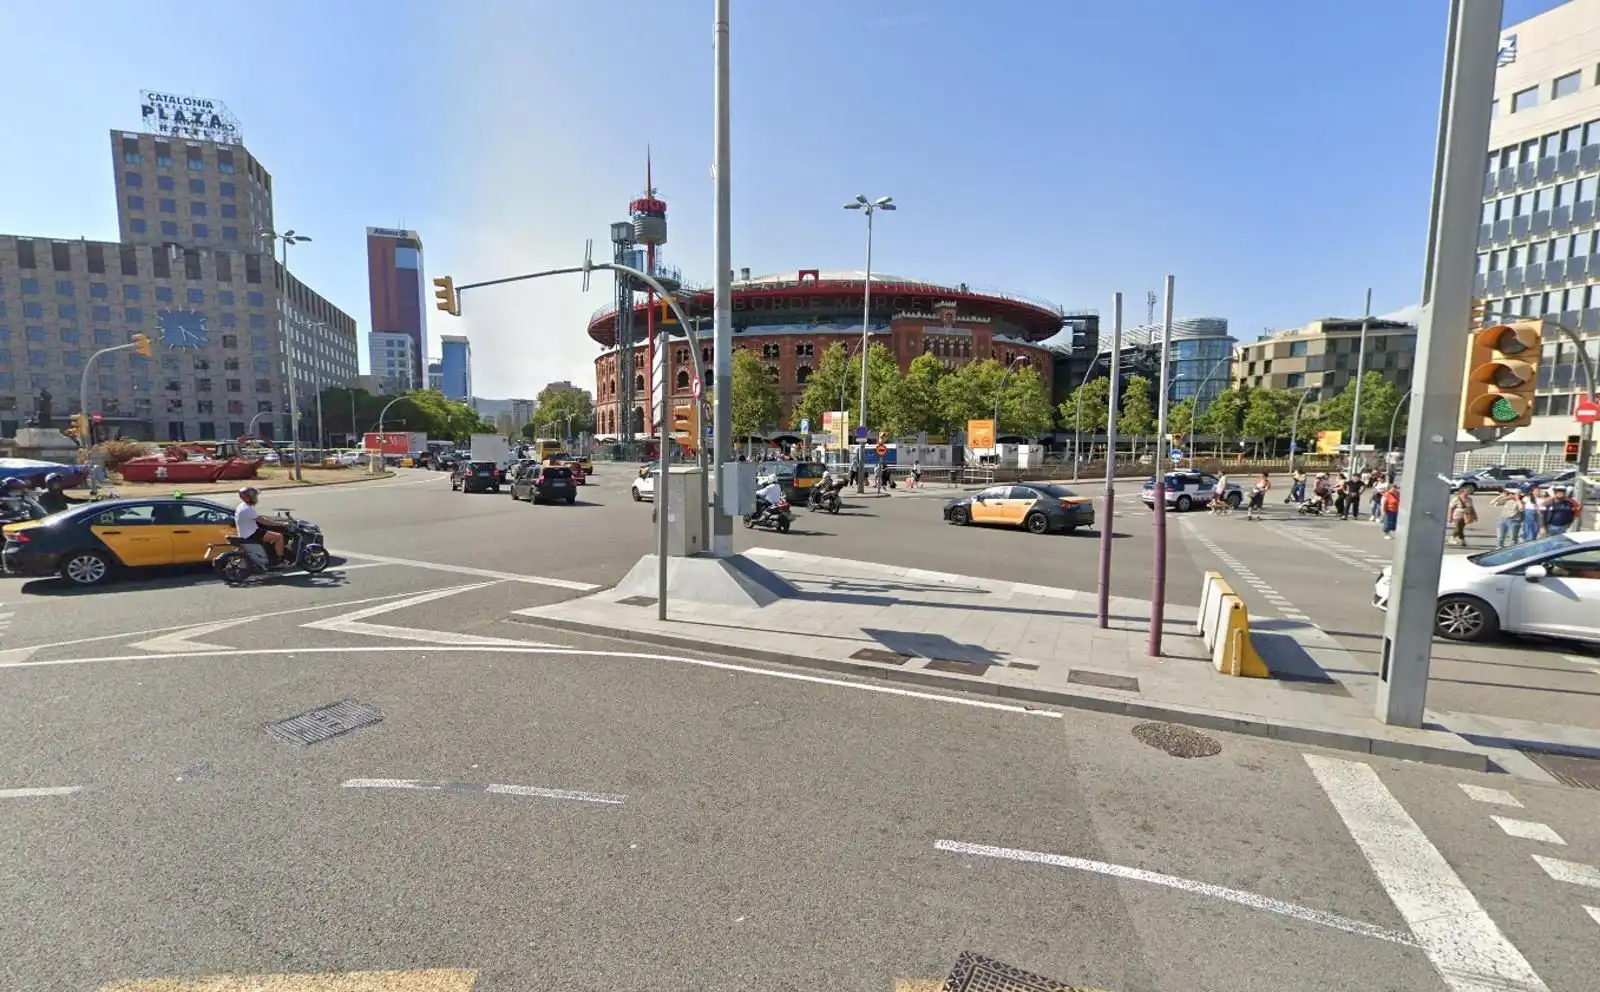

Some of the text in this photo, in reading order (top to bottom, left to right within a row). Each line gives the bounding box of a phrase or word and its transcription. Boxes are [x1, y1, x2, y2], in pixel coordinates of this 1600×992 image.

[147, 92, 214, 110] CATALONIA
[141, 104, 223, 129] PLAZA
[374, 227, 399, 237] Allianz
